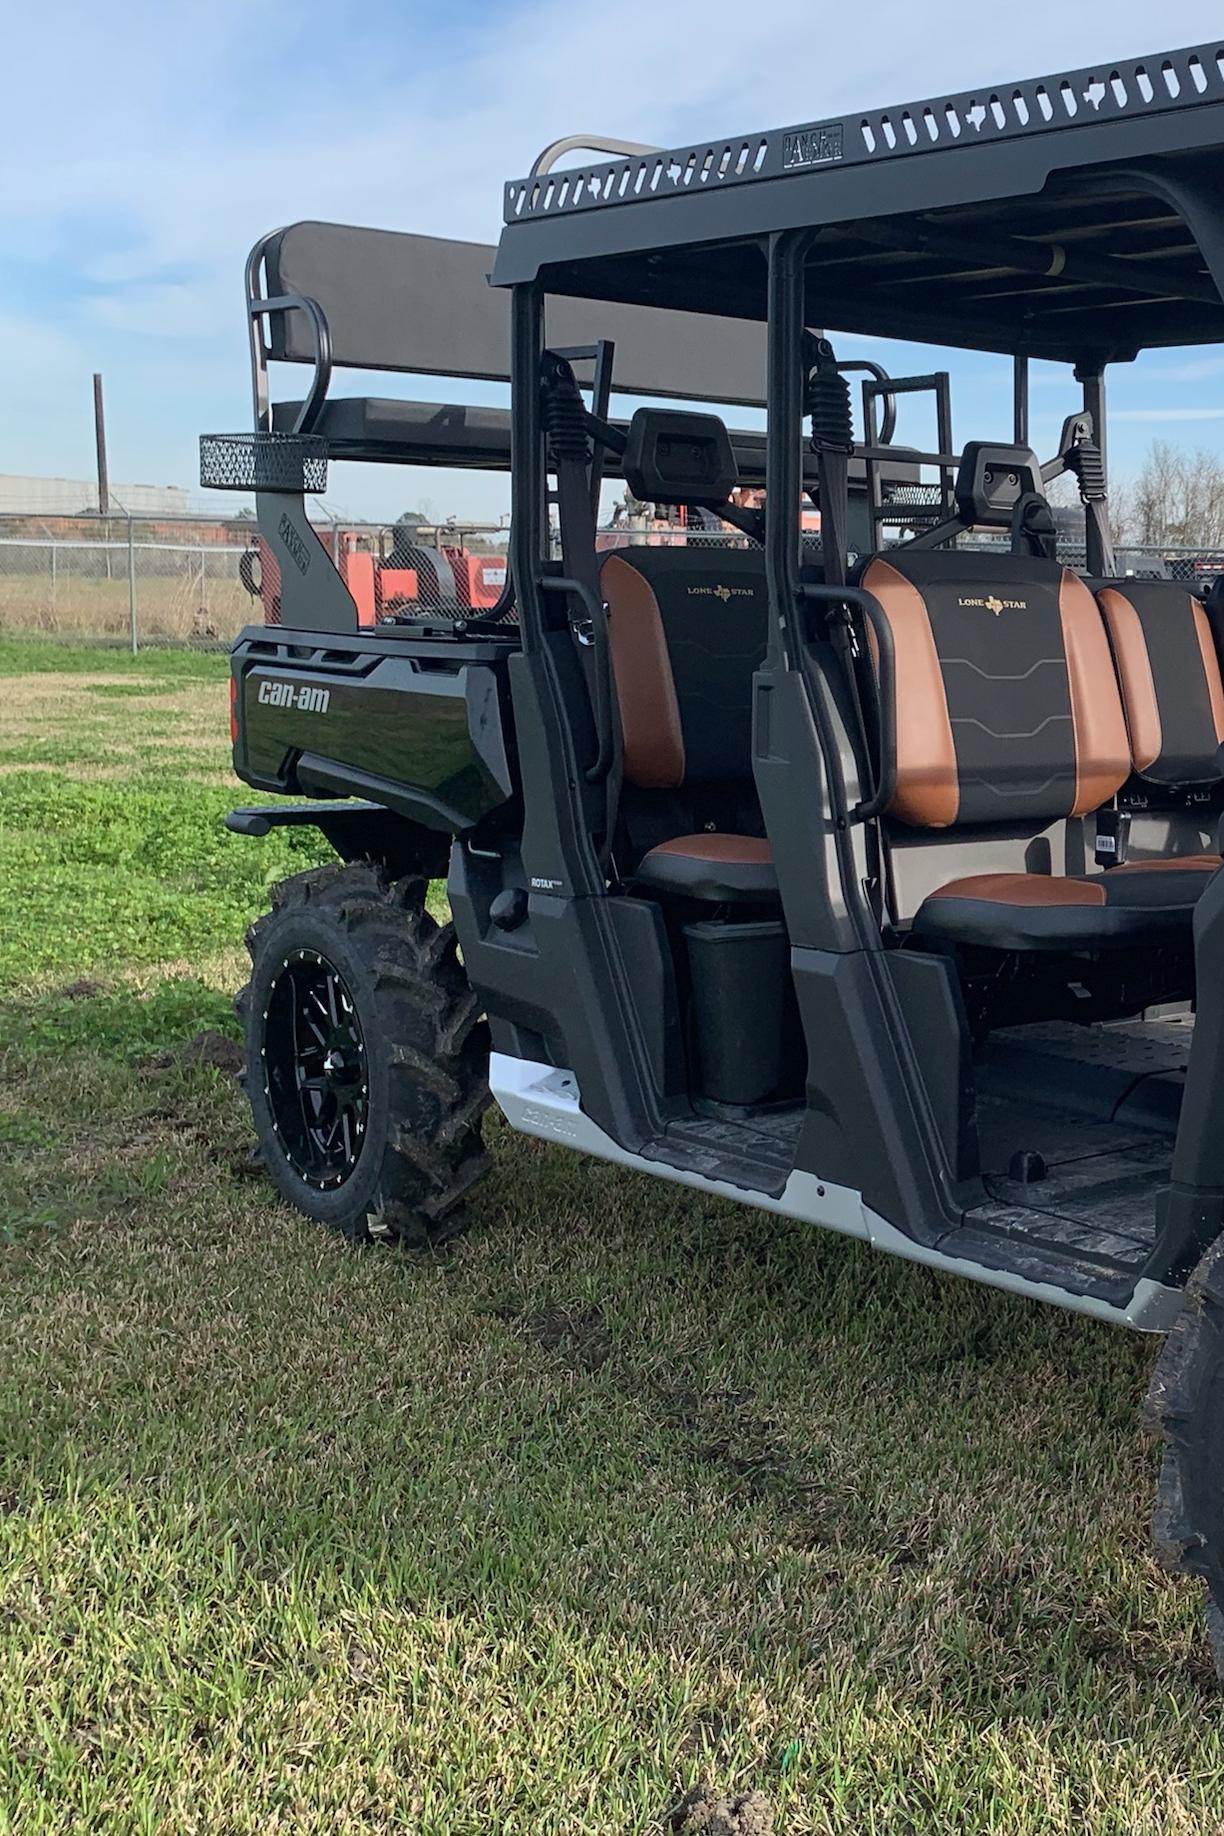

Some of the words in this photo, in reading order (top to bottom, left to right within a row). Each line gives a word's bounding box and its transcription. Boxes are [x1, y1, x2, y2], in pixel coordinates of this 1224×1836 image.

[687, 586, 714, 595] LONE
[730, 588, 754, 596] STAR
[958, 598, 985, 607] LONE
[1002, 600, 1027, 609] STAR
[257, 680, 330, 714] can-am
[531, 877, 554, 889] ROTAX
